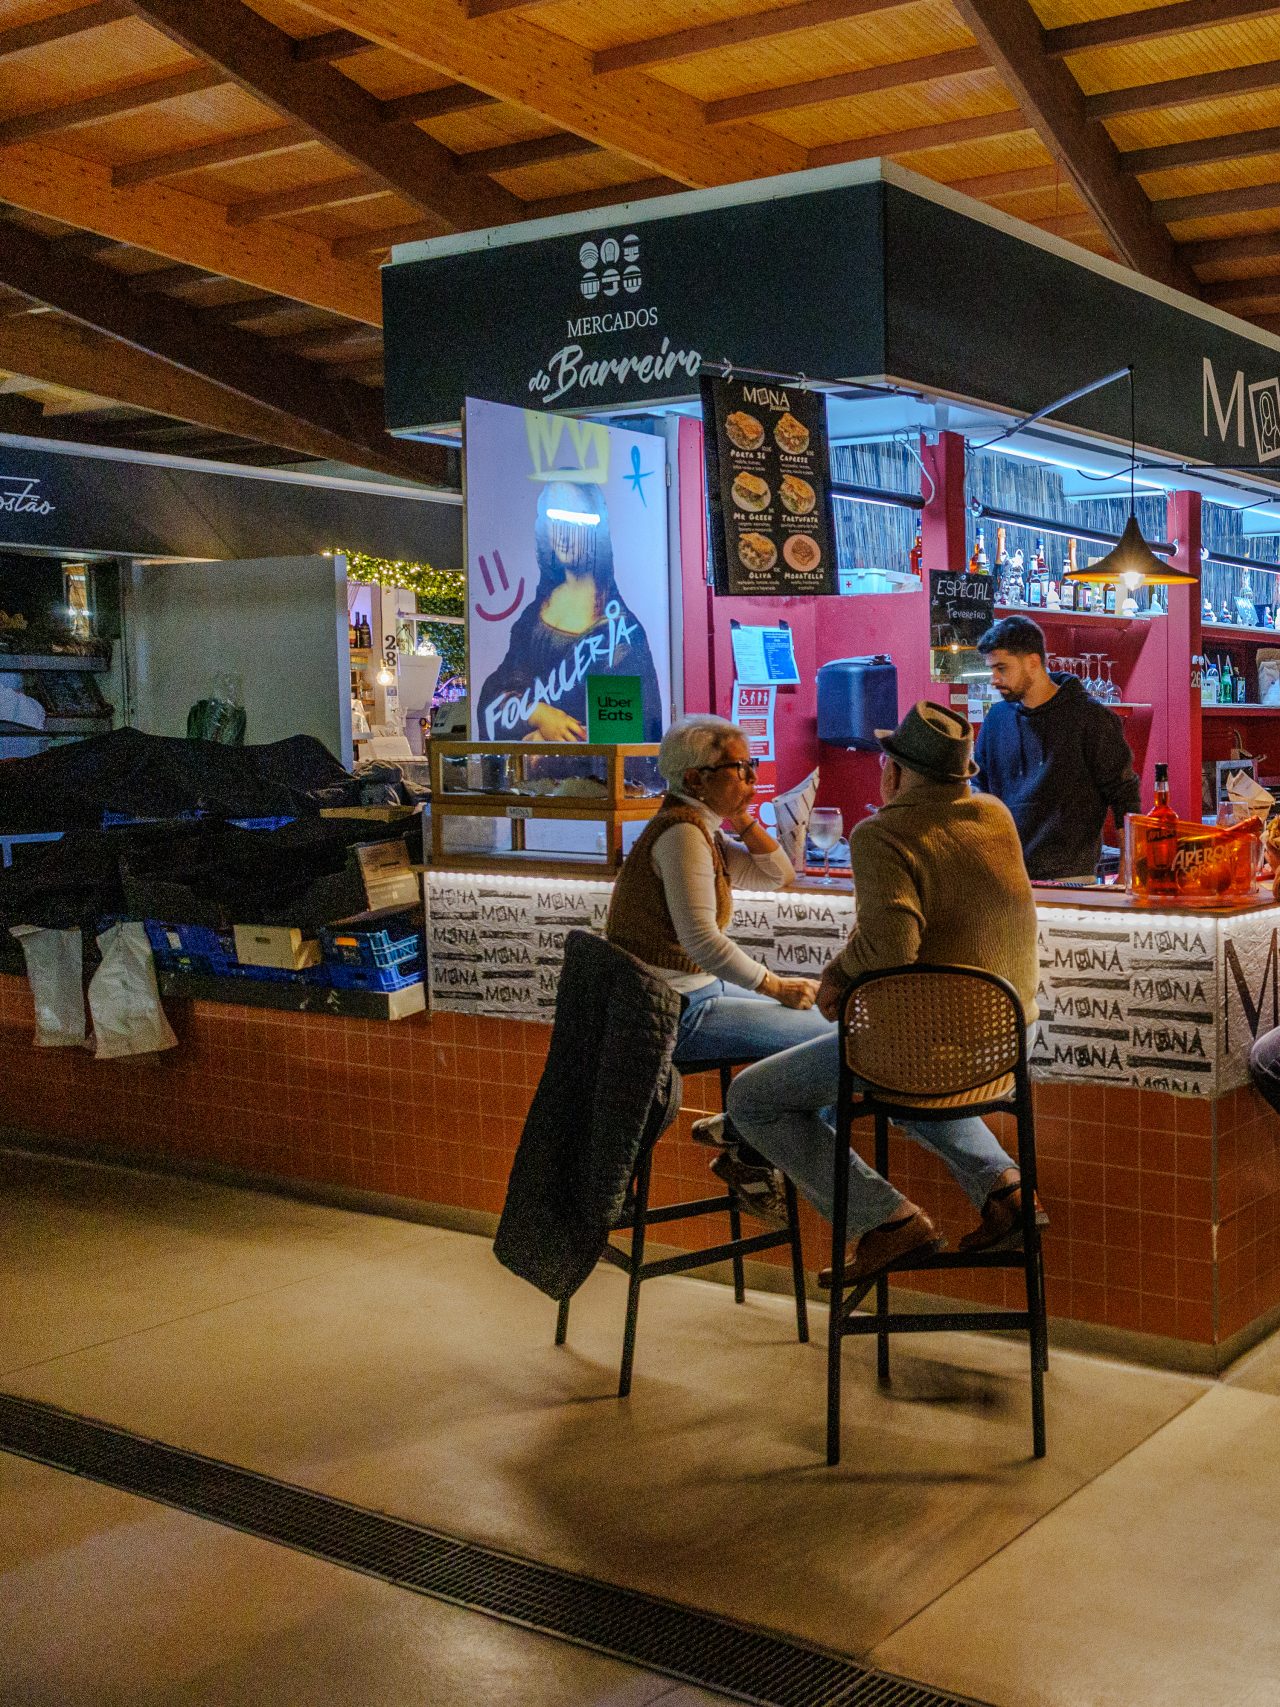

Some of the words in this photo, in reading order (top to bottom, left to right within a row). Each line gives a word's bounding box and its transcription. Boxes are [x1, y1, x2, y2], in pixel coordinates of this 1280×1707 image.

[567, 307, 658, 338] MERCADOS
[529, 370, 550, 392] do
[543, 337, 701, 403] Barreiro
[598, 696, 632, 708] Uber
[598, 709, 633, 721] Eats
[483, 946, 532, 965] MONA
[1133, 931, 1207, 954] MONA
[1054, 948, 1124, 973] MONA
[1133, 978, 1207, 1004] MONA
[1054, 996, 1124, 1022] MONA
[1132, 1026, 1206, 1058] MONA
[1054, 1043, 1124, 1071] MONA
